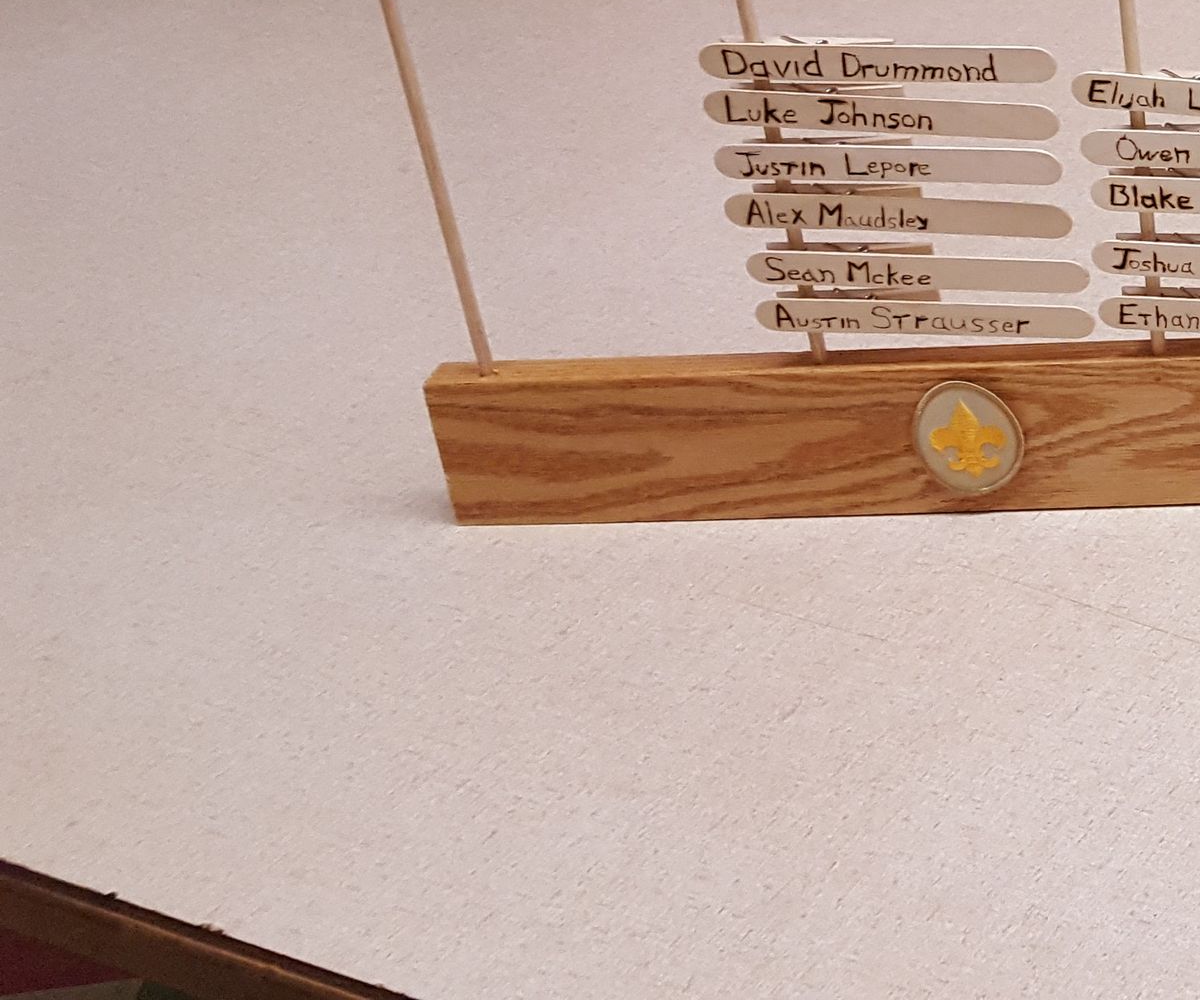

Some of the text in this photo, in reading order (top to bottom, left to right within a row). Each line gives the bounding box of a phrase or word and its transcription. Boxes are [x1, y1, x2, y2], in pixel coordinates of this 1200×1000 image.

[721, 49, 998, 82] David Drummond
[1088, 80, 1165, 109] Elijah
[725, 94, 934, 131] Luke Johnson
[1116, 134, 1190, 164] Owen
[845, 152, 932, 179] Lepore
[1109, 183, 1194, 210] Blake
[745, 199, 929, 230] Alex Maudsley
[765, 257, 836, 284] Sean
[1112, 247, 1194, 275] Joshua
